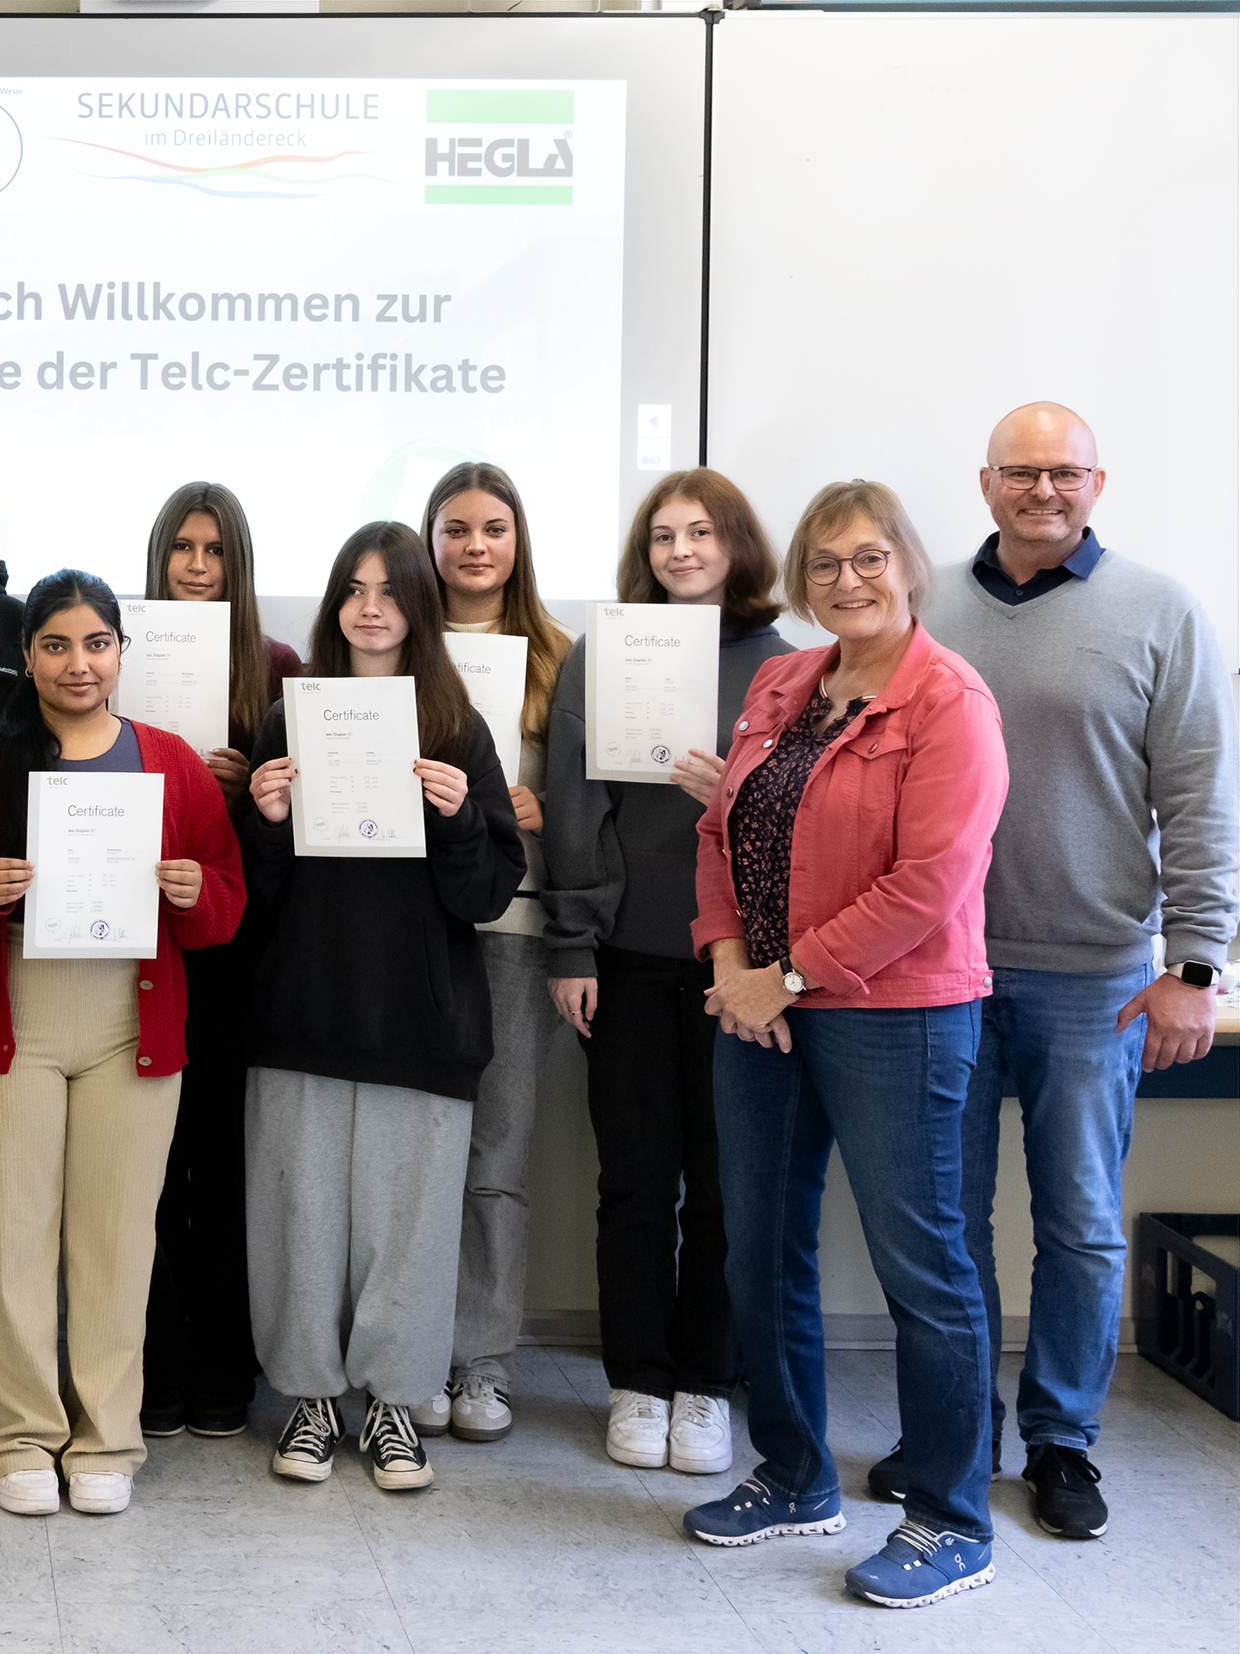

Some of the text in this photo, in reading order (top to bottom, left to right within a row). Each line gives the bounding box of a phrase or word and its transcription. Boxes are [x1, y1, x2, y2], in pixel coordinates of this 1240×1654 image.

[78, 92, 379, 120] SEKUNDARSCHULE
[144, 129, 307, 147] im Dreiländereck
[58, 281, 360, 322] Willkommen
[375, 293, 452, 323] zur
[37, 350, 117, 391] der
[130, 350, 507, 395] Telc-Zertifikate
[127, 604, 146, 613] telc
[604, 607, 624, 616] telc
[146, 631, 196, 643] Certificate
[625, 634, 681, 647] Certificate
[458, 662, 491, 674] tificate
[300, 682, 321, 691] telc
[323, 709, 379, 721] Certificate
[47, 776, 68, 786] telc
[68, 804, 124, 817] Certificate
